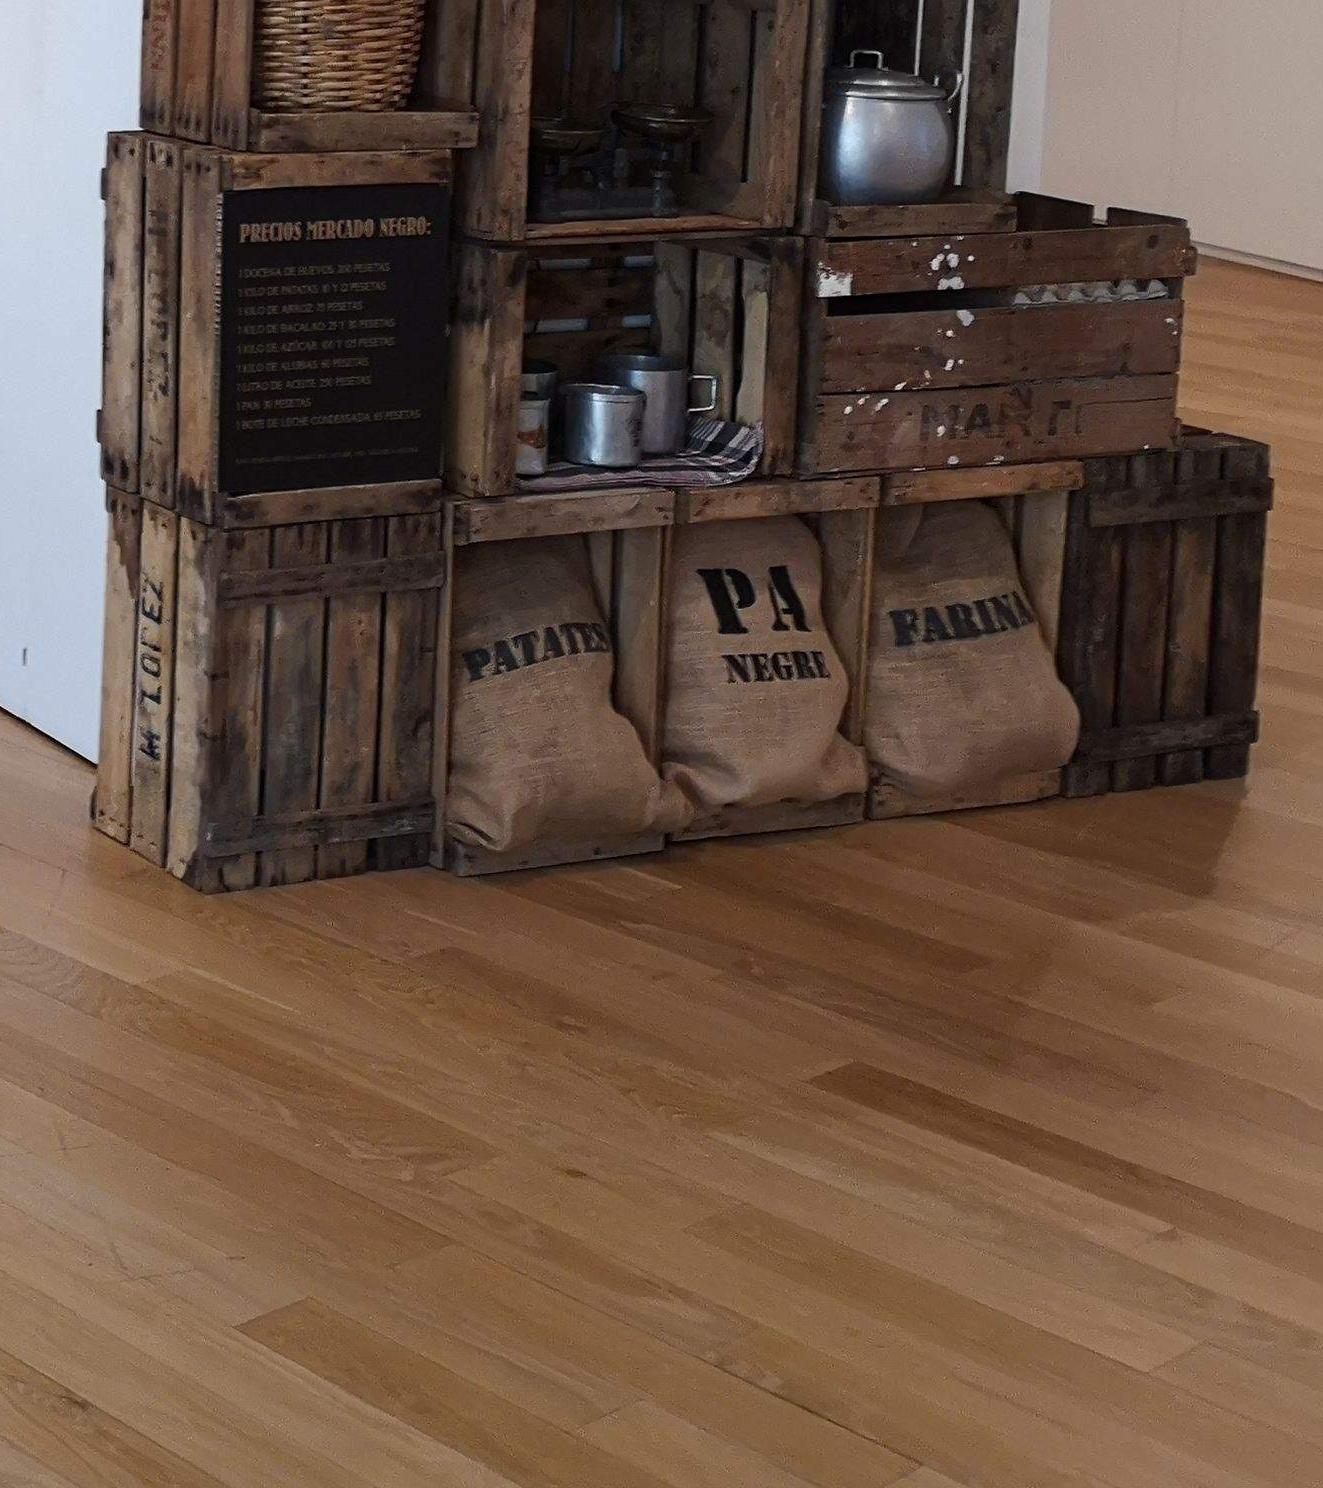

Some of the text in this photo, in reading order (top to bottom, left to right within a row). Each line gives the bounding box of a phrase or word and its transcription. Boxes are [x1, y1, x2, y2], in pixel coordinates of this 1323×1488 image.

[239, 216, 432, 243] PRECIOS MERCADO NEGRO:
[695, 565, 812, 634] PA
[462, 622, 611, 682] PATATES
[721, 651, 831, 684] NEGRE
